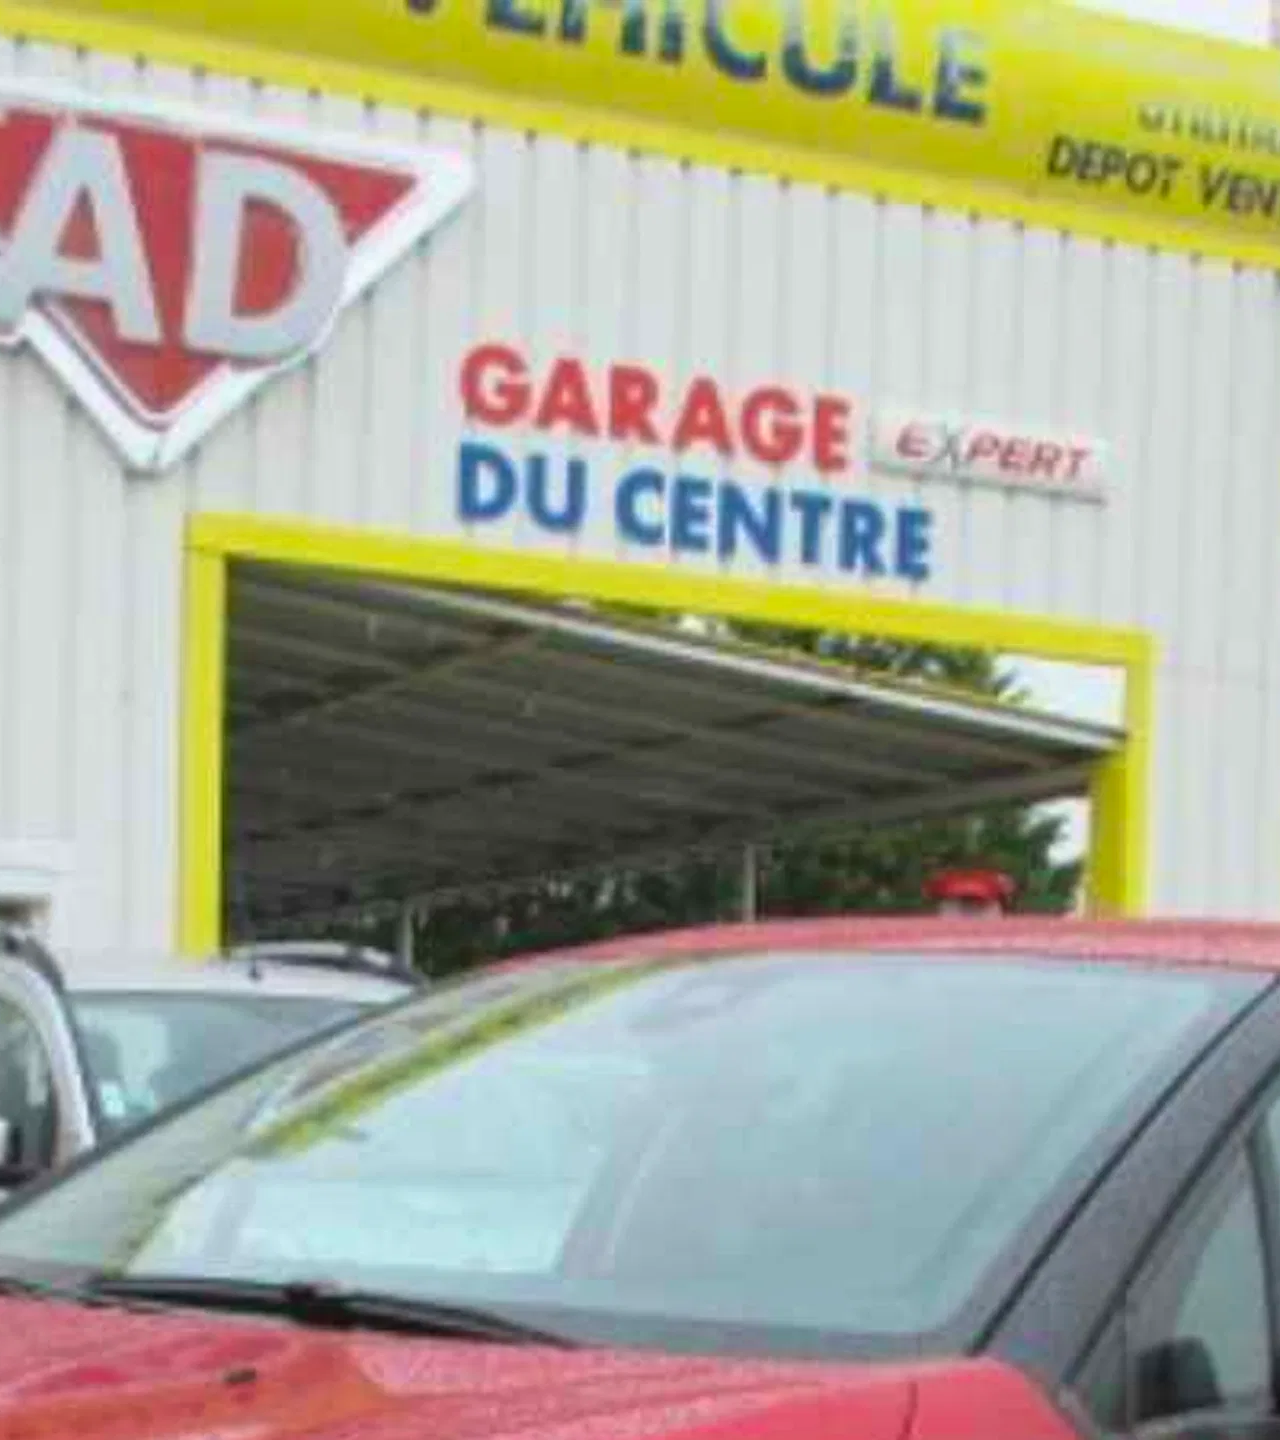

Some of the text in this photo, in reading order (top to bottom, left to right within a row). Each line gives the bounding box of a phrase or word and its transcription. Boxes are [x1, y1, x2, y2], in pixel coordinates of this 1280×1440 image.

[1046, 134, 1183, 200] DEPOT
[459, 343, 853, 473] GARAGE
[895, 419, 1094, 482] EXPERT
[457, 441, 935, 582] DU CENTRE
